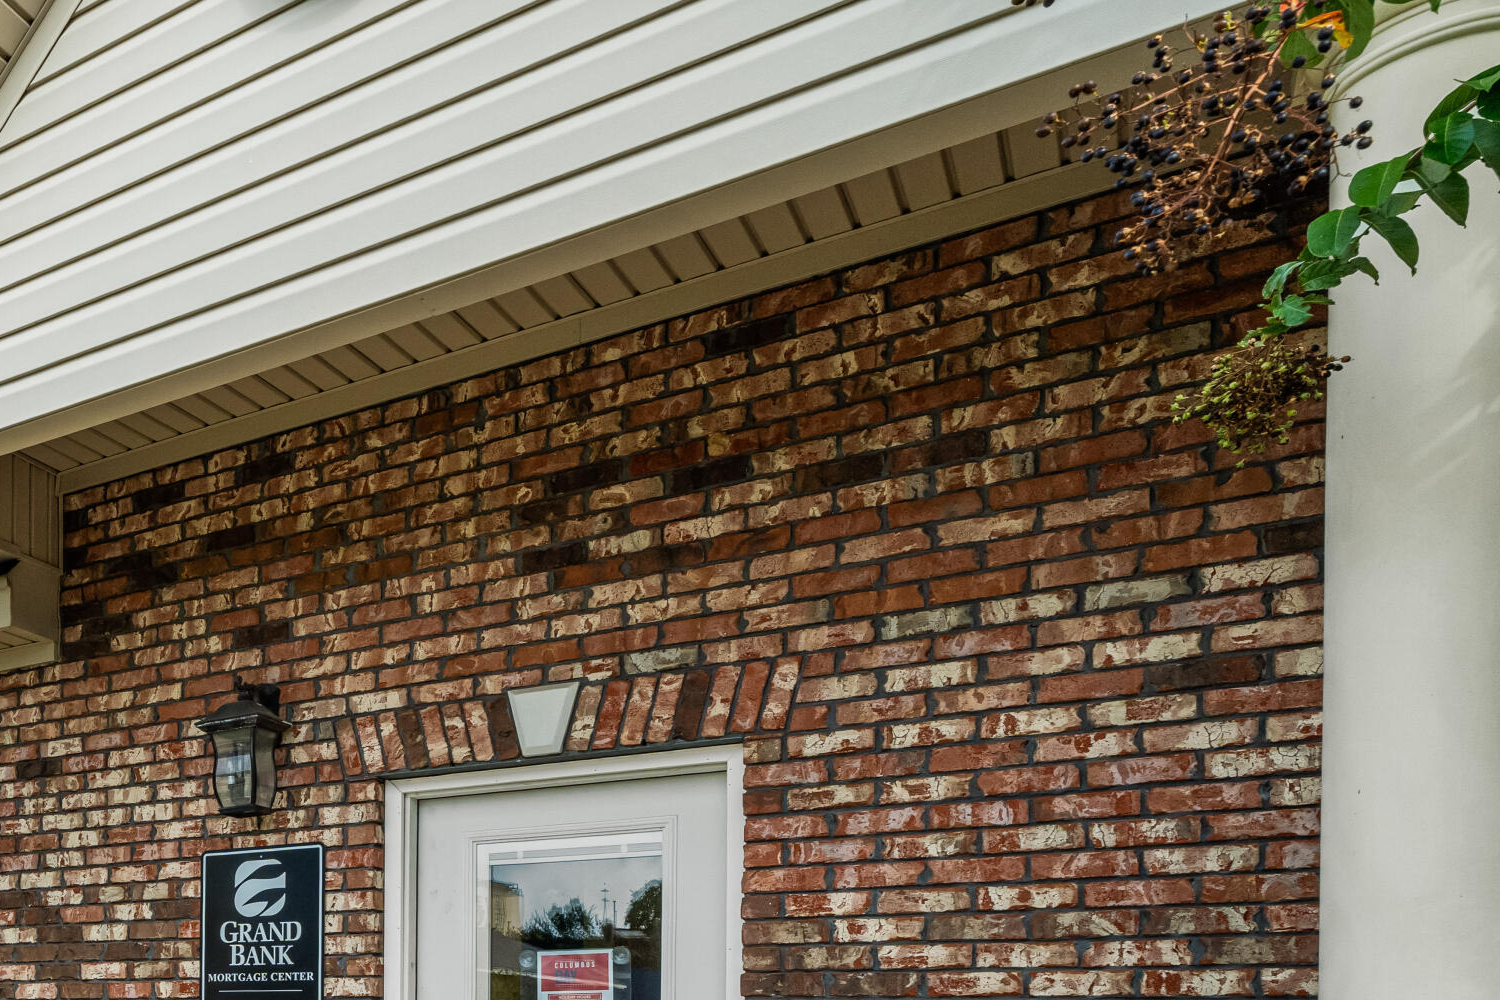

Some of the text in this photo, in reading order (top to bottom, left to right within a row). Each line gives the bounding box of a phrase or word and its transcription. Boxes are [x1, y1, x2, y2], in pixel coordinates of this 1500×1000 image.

[220, 921, 302, 944] GRAND
[229, 944, 294, 966] BANK
[554, 961, 596, 969] COLUMBUS
[208, 971, 315, 982] MORTGAGE CENTER
[555, 969, 577, 984] DAY
